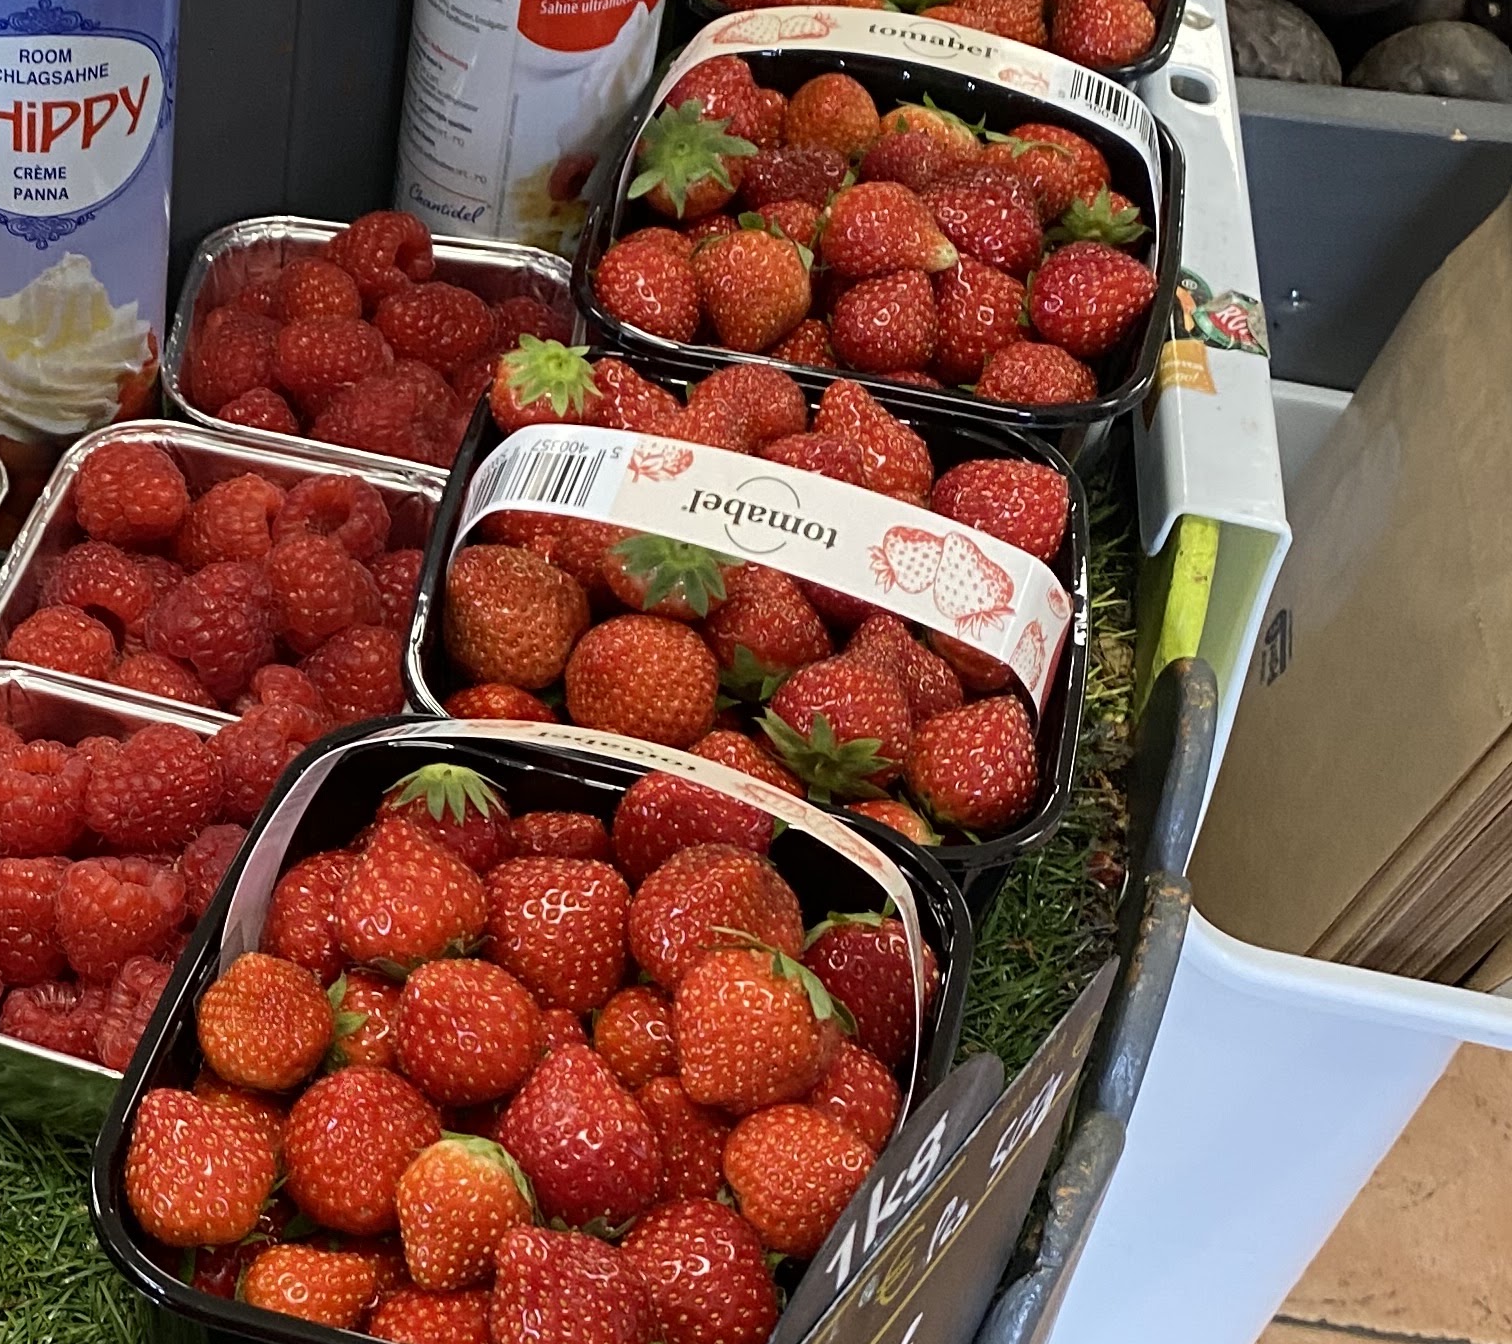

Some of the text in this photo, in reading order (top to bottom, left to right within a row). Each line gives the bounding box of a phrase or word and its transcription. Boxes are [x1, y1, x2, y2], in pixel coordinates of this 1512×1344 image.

[540, 0, 579, 15] Sahne
[867, 22, 1000, 60] tomabel
[18, 47, 74, 64] ROOM
[12, 164, 68, 181] CRÈME
[12, 186, 70, 202] PANNA
[408, 182, 486, 224] Chantidel
[688, 487, 839, 551] tomabel
